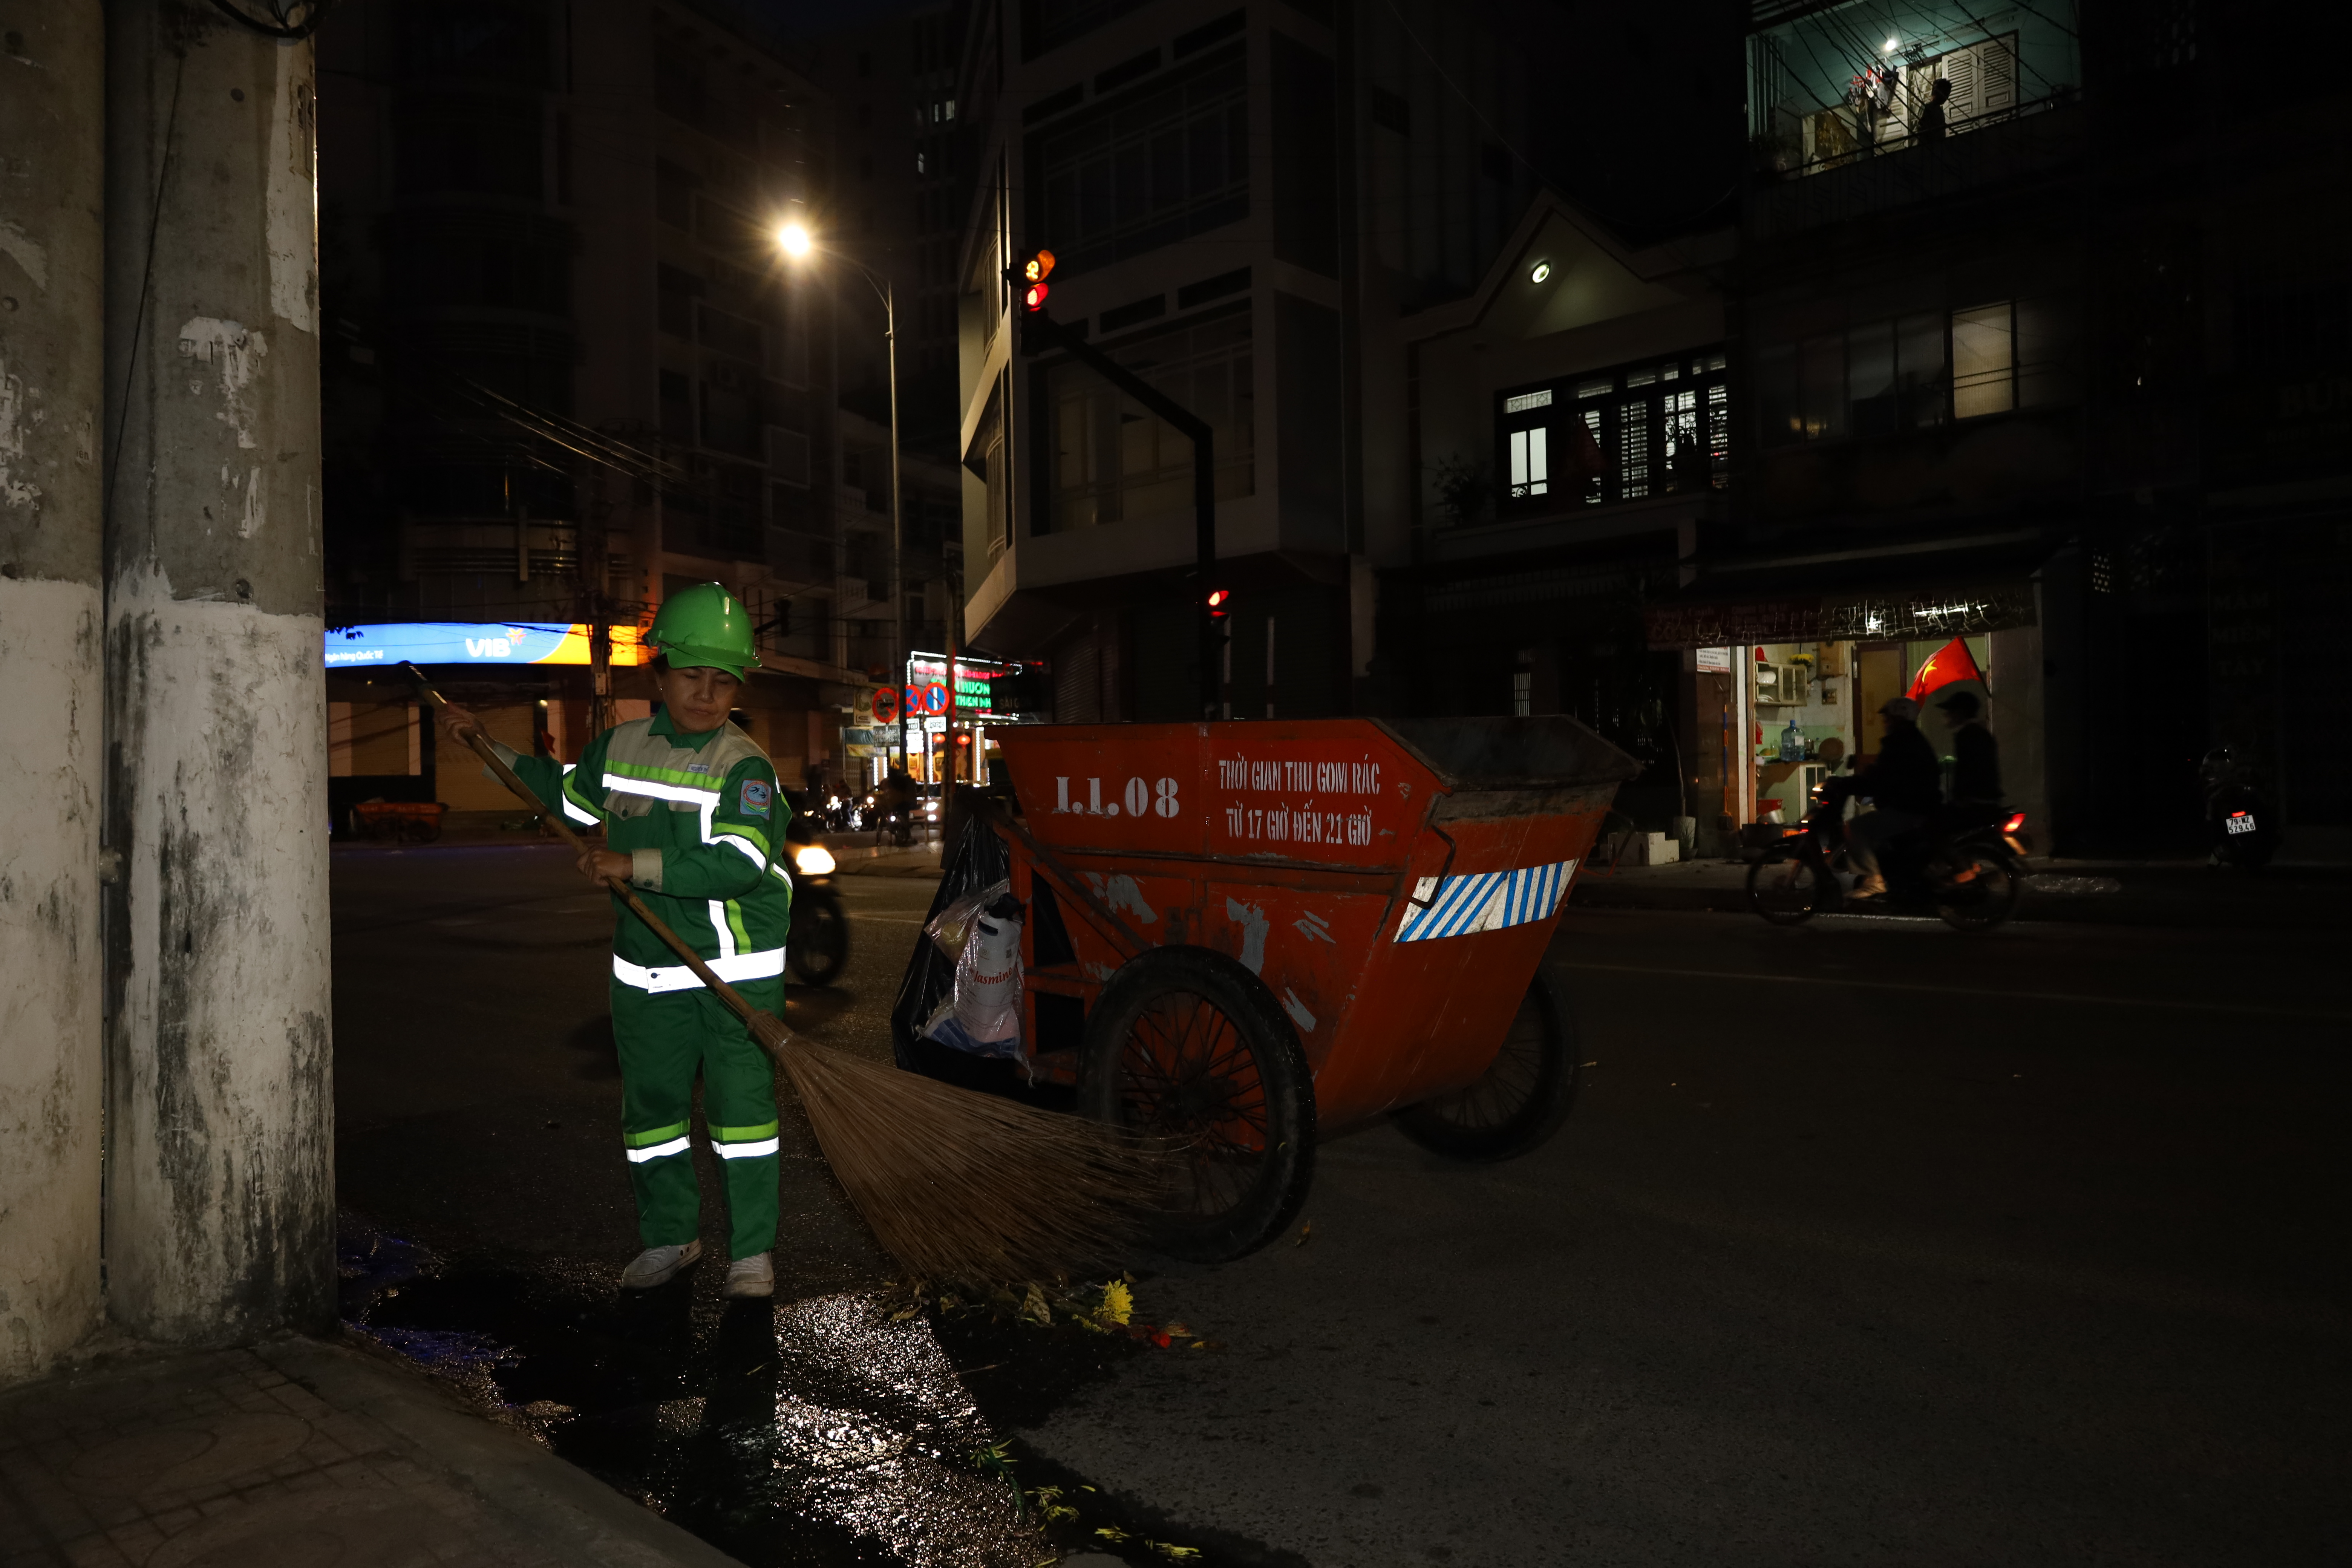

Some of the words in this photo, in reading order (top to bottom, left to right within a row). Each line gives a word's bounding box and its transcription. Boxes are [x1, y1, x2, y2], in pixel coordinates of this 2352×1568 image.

[466, 638, 511, 657] VIB
[1219, 752, 1247, 790] THỜI
[1251, 761, 1281, 791] GIAN
[1285, 761, 1312, 792] THU
[1317, 762, 1347, 793] GOM
[1352, 754, 1380, 795] RÁC
[1226, 800, 1243, 838] TỪ
[1248, 809, 1262, 839] 17
[1267, 802, 1289, 841] GIỜ
[1293, 799, 1321, 842] ĐẾN
[1326, 813, 1343, 844] 21
[1348, 805, 1372, 846] GIỜ
[974, 967, 1012, 985] Jasmine
